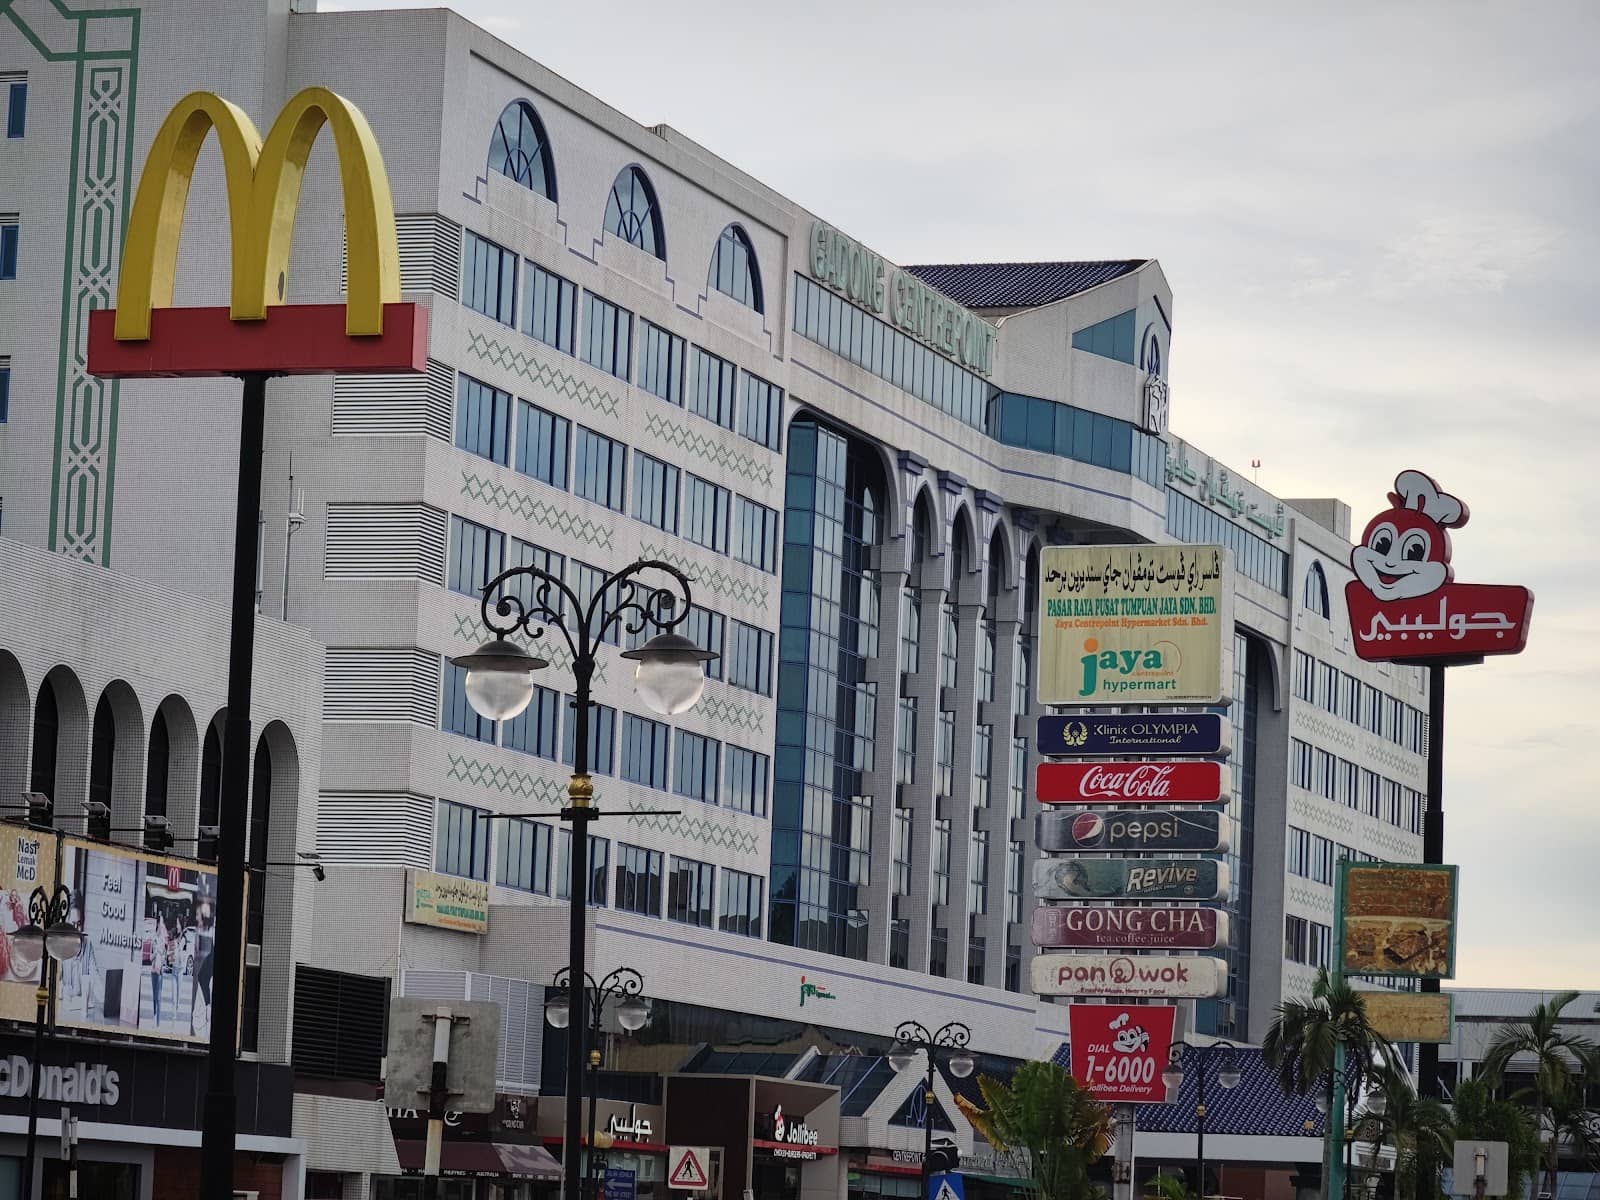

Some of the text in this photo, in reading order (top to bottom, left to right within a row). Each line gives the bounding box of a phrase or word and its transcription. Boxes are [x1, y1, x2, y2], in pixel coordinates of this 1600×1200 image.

[809, 219, 997, 377] GADONG CENTREPOINT
[1047, 596, 1217, 616] PASAR RAYA PUSAT TUMPUAN JAYA SDN. BHD.
[1079, 637, 1163, 696] jaya
[1103, 679, 1177, 693] hypermart
[1094, 723, 1199, 735] Klinik OLYMPIA
[1109, 734, 1182, 744] International
[1110, 817, 1179, 843] pepsi
[16, 864, 36, 881] McD
[1127, 862, 1198, 892] Revive
[103, 874, 122, 894] Feel
[101, 902, 126, 921] Good
[1066, 909, 1142, 932] GONG
[1150, 910, 1205, 933] CHA
[100, 928, 143, 950] Moments
[1058, 966, 1106, 986] pan
[1139, 962, 1189, 982] wok
[1087, 1044, 1110, 1053] DIAL
[1086, 1055, 1155, 1083] 1-6000
[1119, 1084, 1153, 1095] Delivery
[787, 1121, 818, 1146] Jollibee
